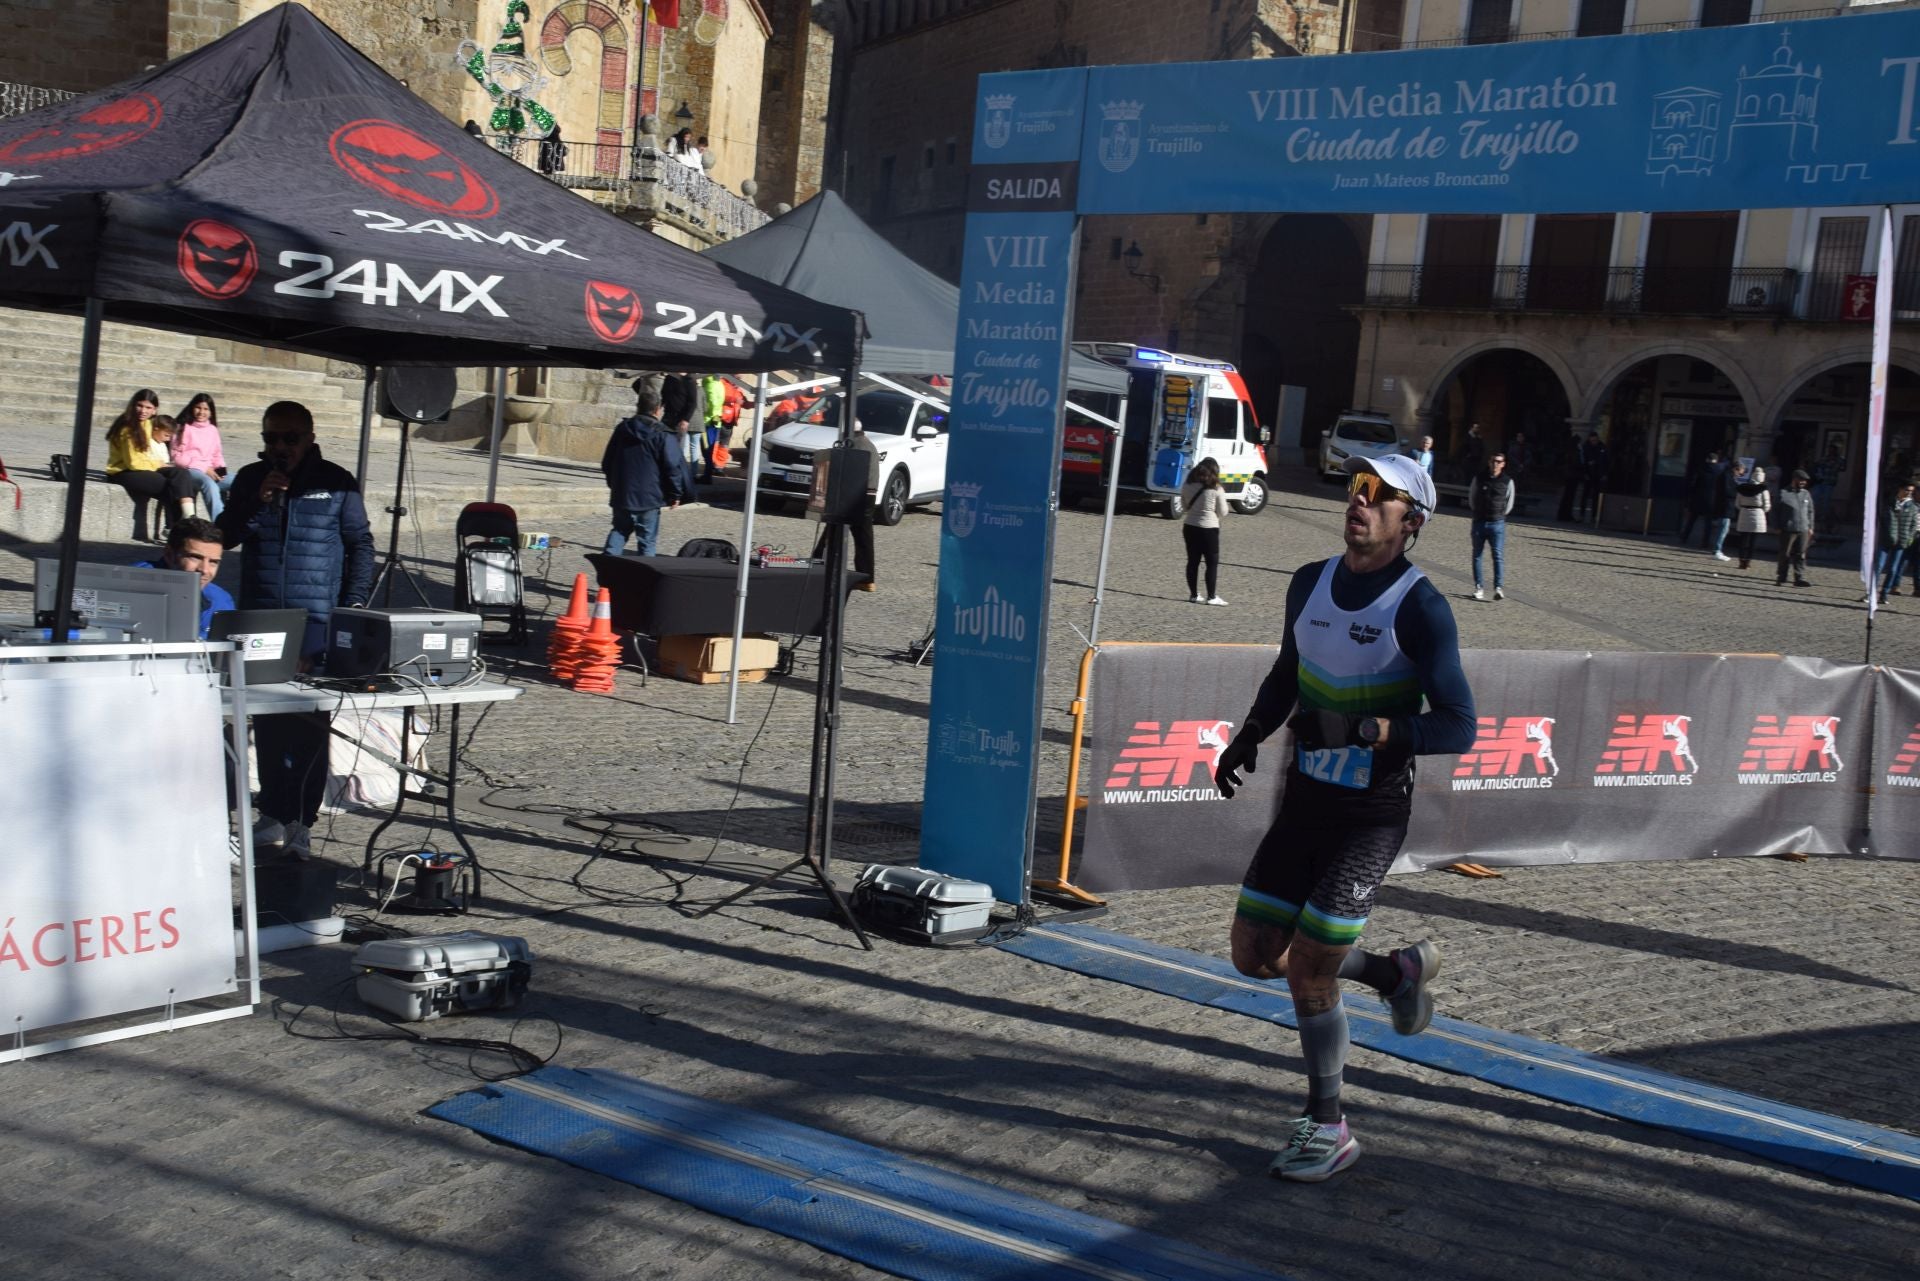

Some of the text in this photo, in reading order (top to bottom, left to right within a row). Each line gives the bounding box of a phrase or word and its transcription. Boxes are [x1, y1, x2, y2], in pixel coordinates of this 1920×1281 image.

[1248, 72, 1618, 121] VIII Media Maratón
[1881, 57, 1920, 145] T
[1016, 121, 1056, 136] Trujillo
[1147, 137, 1203, 157] Trujillo
[1285, 119, 1579, 171] Ciudad de Trujillo
[986, 178, 1062, 200] SALIDA
[1331, 170, 1509, 191] Juan Mateos Broncano
[984, 235, 1049, 268] VIII
[273, 249, 511, 318] 24MX
[973, 281, 1056, 305] Media
[653, 300, 826, 363] 24MX
[965, 318, 1057, 341] Maratón
[974, 350, 1041, 369] Ciudad de
[961, 372, 1050, 418] Trujillo
[982, 513, 1024, 529] Trujillo
[977, 728, 1021, 757] Trujillo
[1452, 773, 1553, 791] www.musicrun.es
[1593, 771, 1693, 788] www.musicrun.es
[1738, 769, 1837, 785] www.musicrun.es
